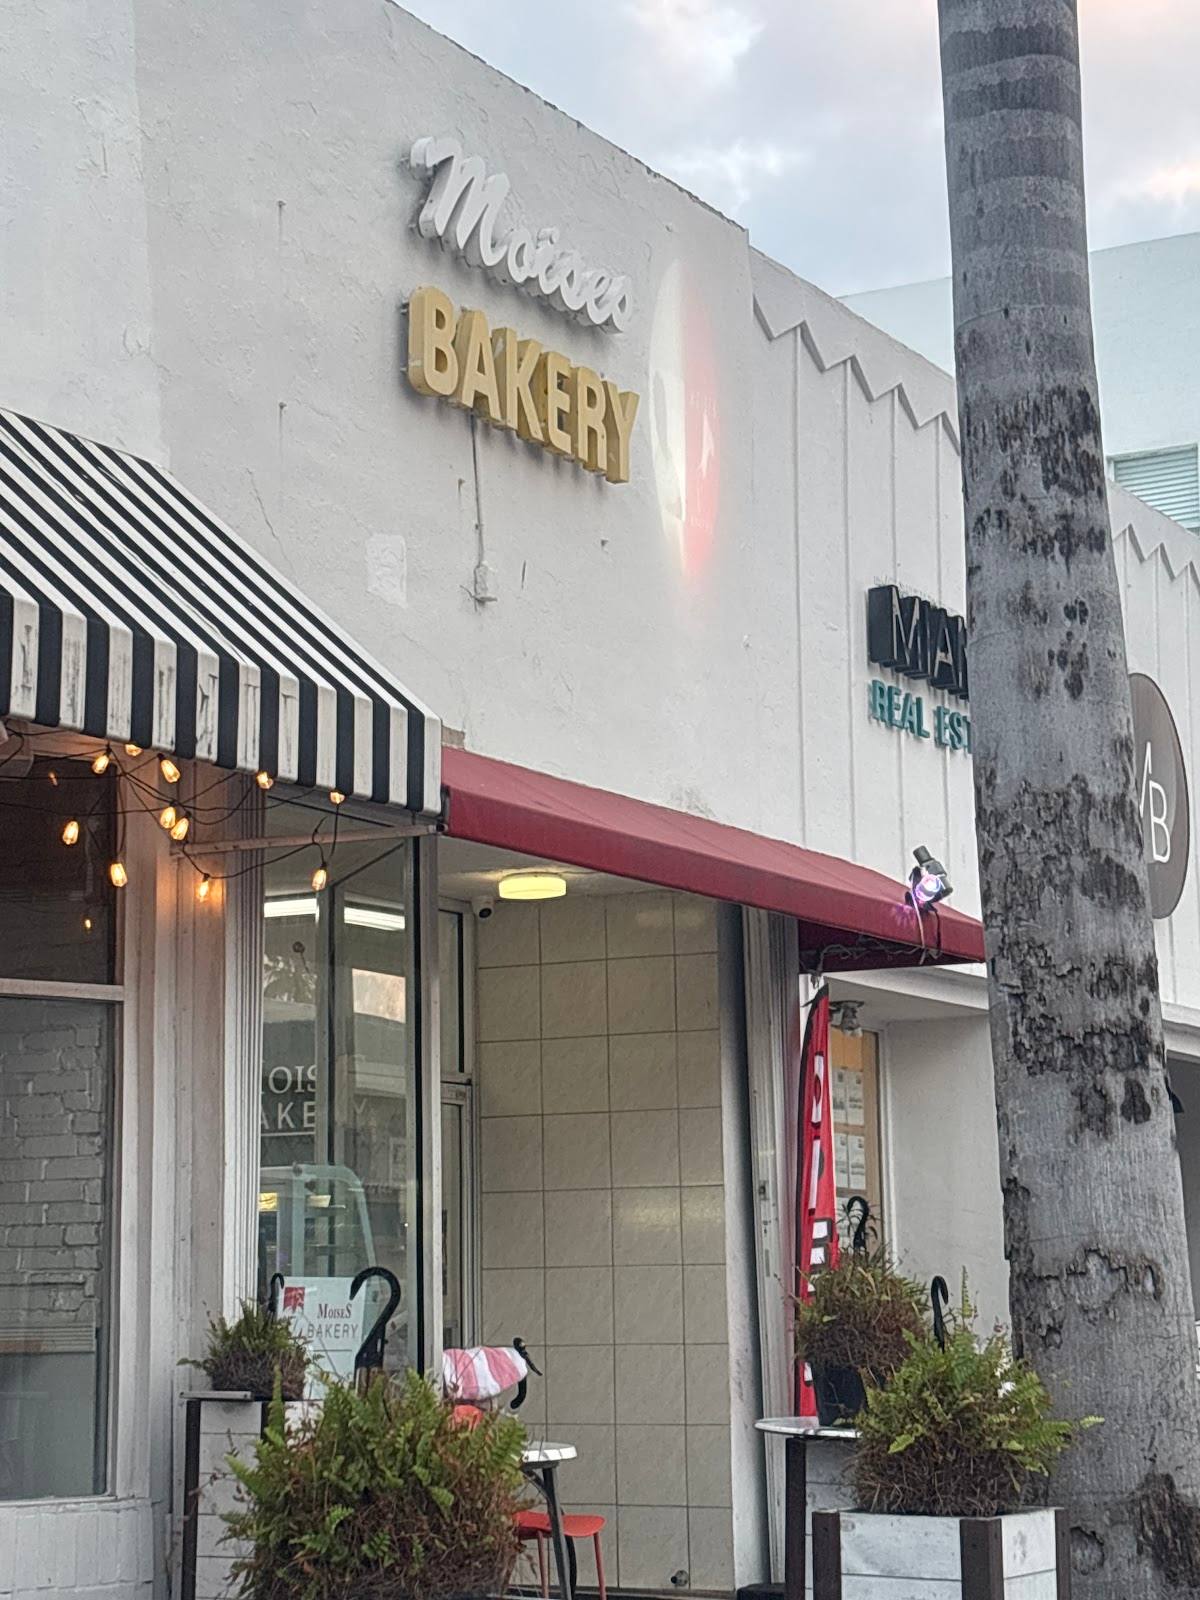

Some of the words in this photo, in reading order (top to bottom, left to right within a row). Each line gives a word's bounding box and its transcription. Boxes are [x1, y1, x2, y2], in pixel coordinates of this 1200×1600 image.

[408, 286, 640, 484] BAKERY
[869, 679, 930, 739] REAL
[307, 1323, 359, 1339] BAKERY
